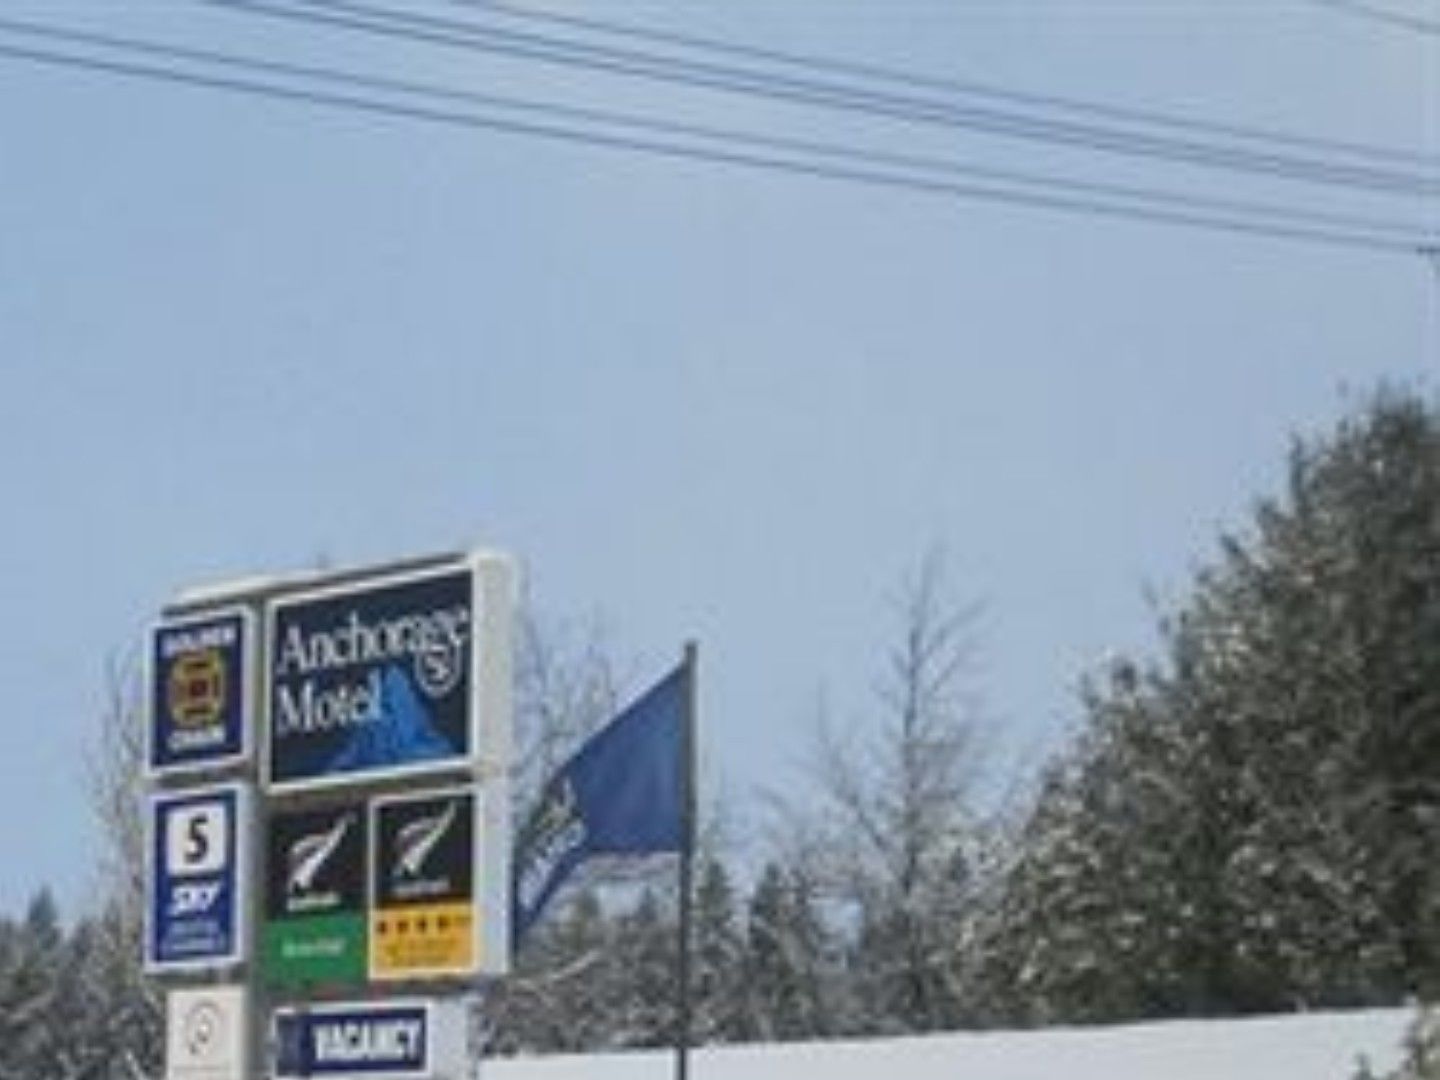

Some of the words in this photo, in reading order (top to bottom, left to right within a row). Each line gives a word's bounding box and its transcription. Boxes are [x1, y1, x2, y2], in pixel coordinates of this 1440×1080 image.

[275, 608, 468, 676] Anchorage
[275, 667, 382, 736] Motel
[183, 814, 209, 865] 5
[314, 1020, 421, 1062] VACANCY
